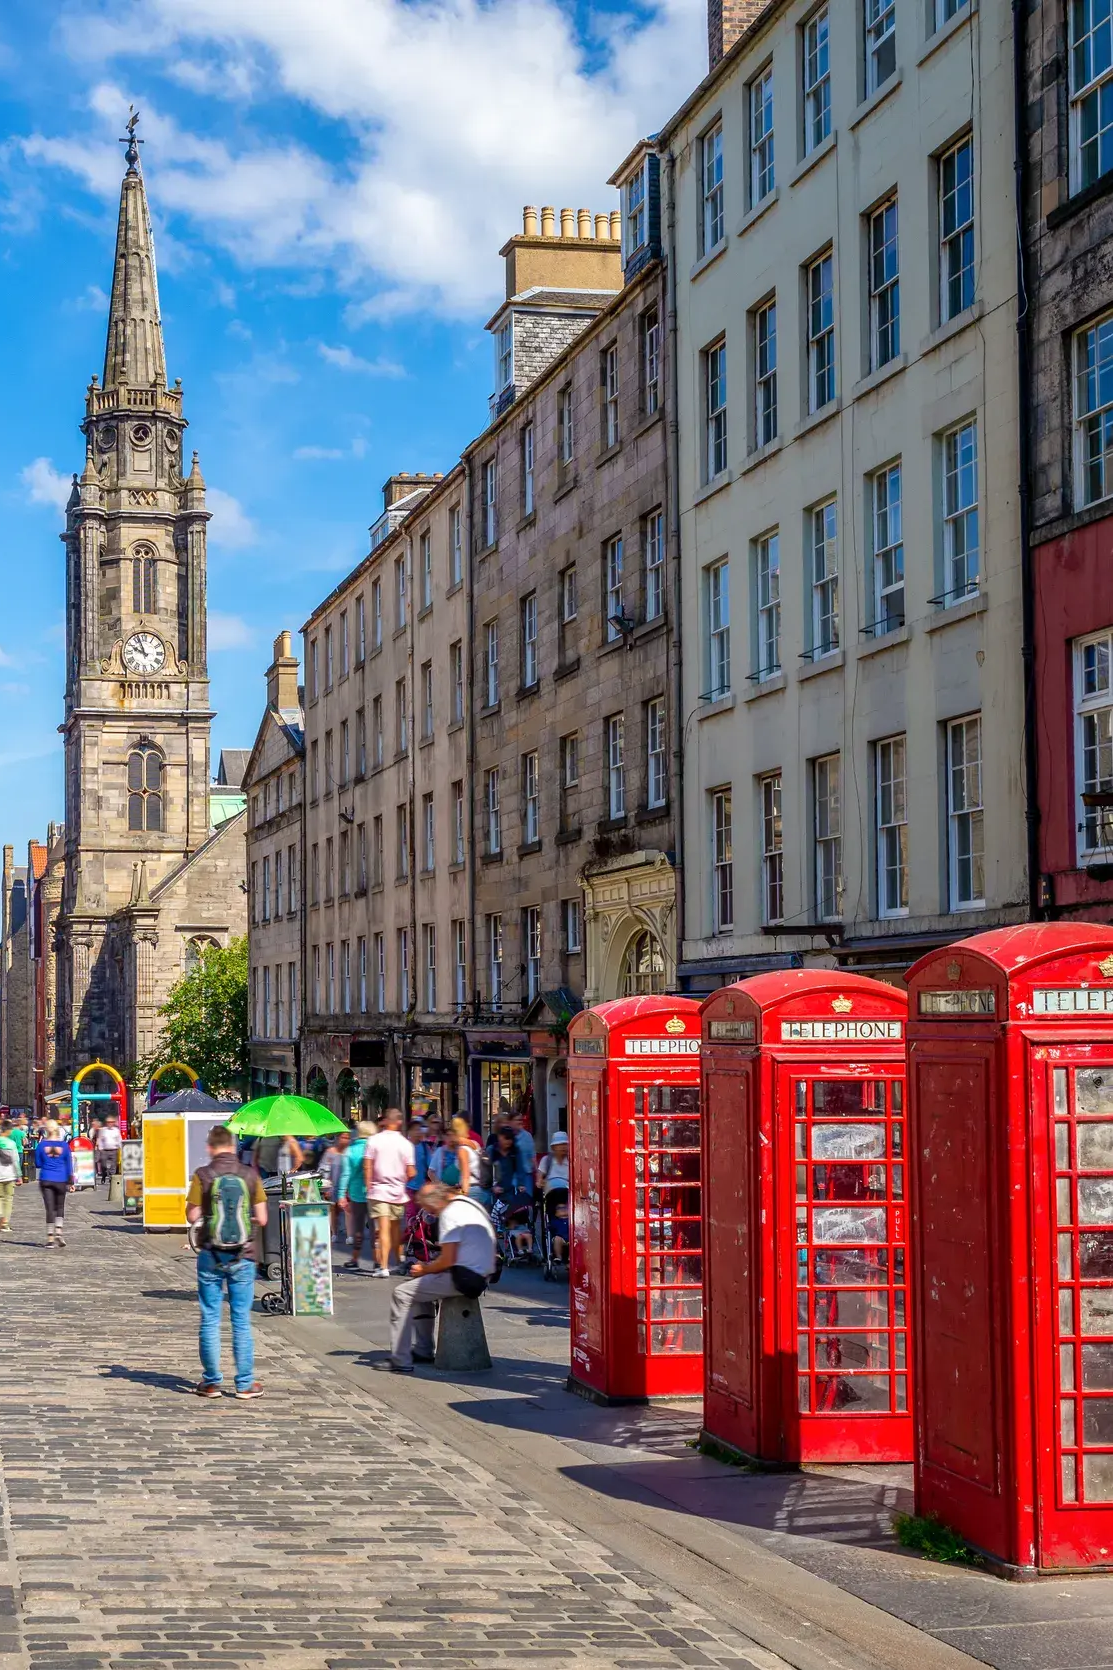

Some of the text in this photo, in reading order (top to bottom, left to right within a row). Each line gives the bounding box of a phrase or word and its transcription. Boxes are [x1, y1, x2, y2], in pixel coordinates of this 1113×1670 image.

[1039, 990, 1113, 1011] TELEP
[786, 1022, 897, 1038] TELEPHONE
[629, 1040, 699, 1053] TELEPHO
